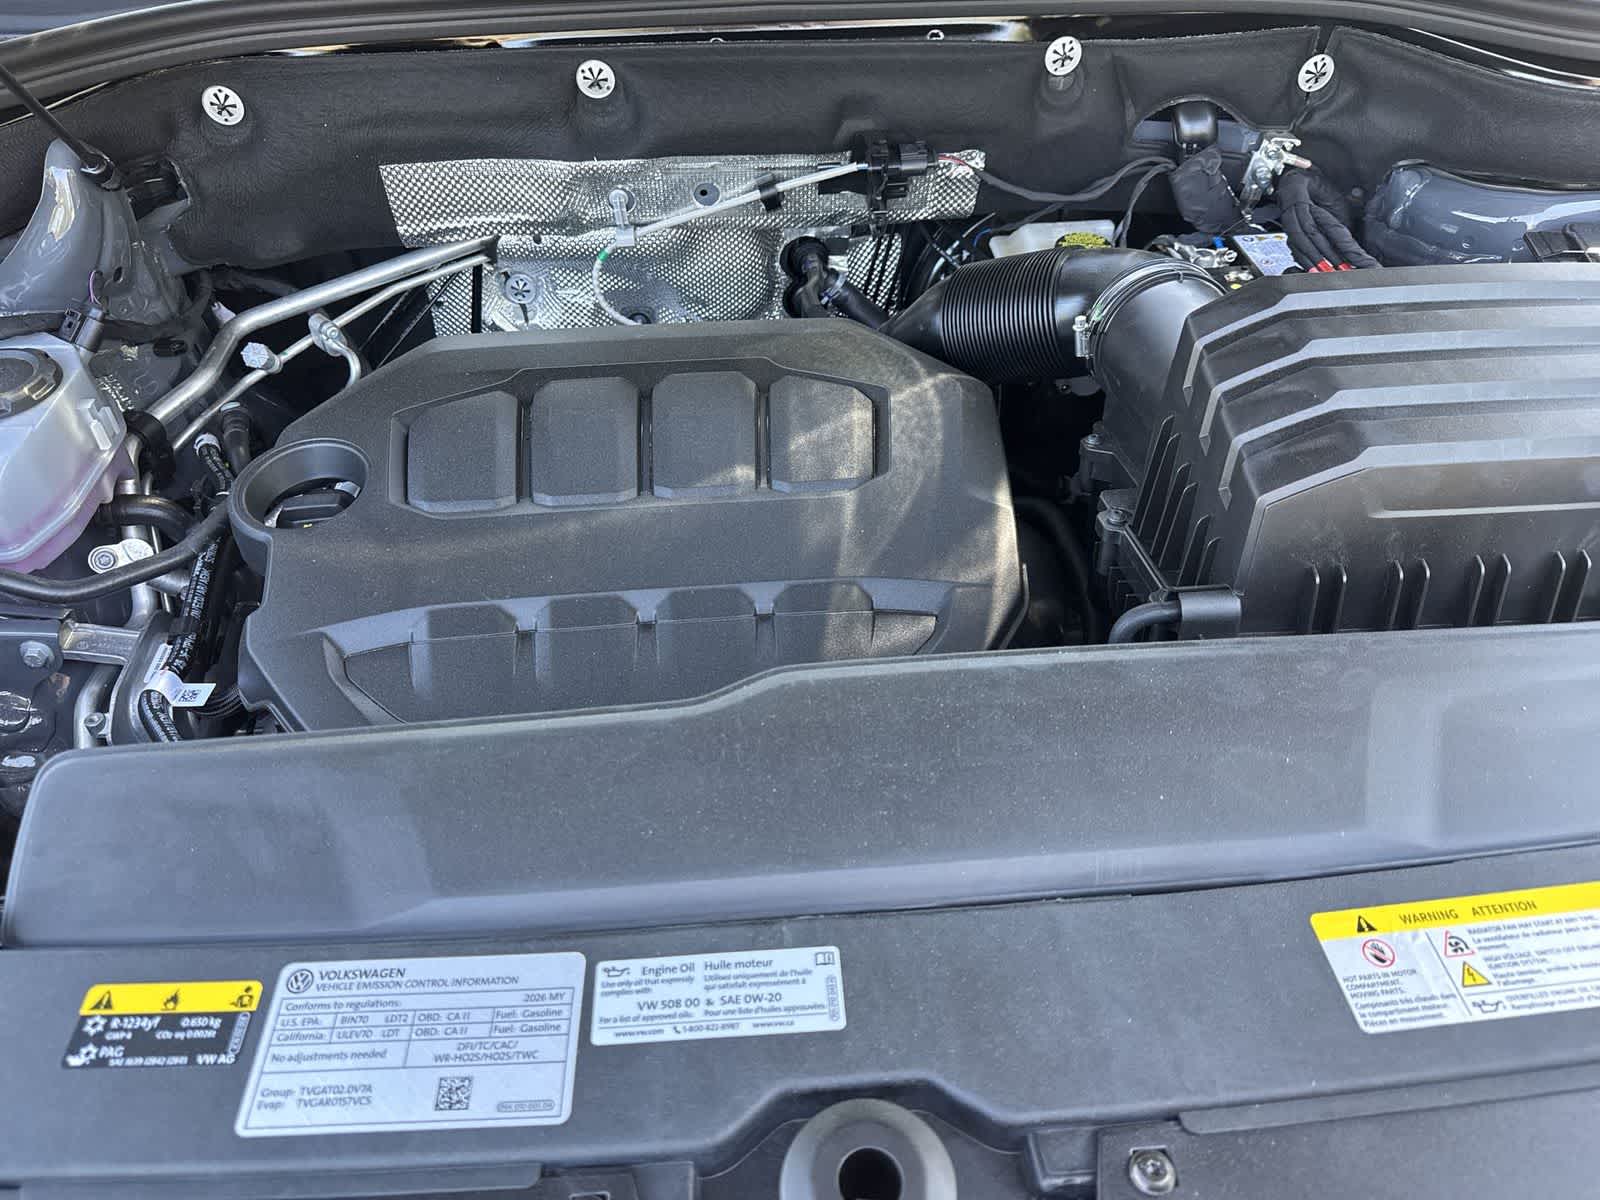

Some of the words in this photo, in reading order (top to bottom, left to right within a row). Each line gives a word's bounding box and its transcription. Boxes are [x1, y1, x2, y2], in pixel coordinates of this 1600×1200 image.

[1400, 909, 1458, 925] WARNING
[1471, 900, 1537, 917] ATTENTION
[705, 960, 732, 971] Huile
[735, 959, 773, 969] moteur
[317, 968, 406, 981] VOLKSWAGEN
[642, 965, 677, 978] Engine
[680, 963, 695, 973] Oil
[1342, 975, 1357, 983] HOT
[1358, 972, 1380, 980] PARTS
[315, 982, 354, 992] VEHICLE
[356, 981, 401, 990] EMISSION
[404, 979, 448, 988] CONTROL
[451, 976, 519, 987] INFORMATION
[524, 993, 546, 1002] 2026
[549, 993, 566, 1001] MY
[637, 1001, 658, 1011] VW
[660, 999, 681, 1009] 508
[685, 998, 700, 1008] 00
[706, 998, 714, 1006] &
[720, 995, 741, 1005] SAE
[744, 993, 782, 1004] 0W-20
[286, 1002, 331, 1011] Conforms
[334, 1001, 345, 1009] to
[384, 1014, 409, 1023] LDT2
[418, 1013, 441, 1022] OBD:
[496, 1010, 516, 1019] Fuel:
[522, 1008, 562, 1018] Gasoline
[415, 1028, 439, 1036] OBD:
[494, 1025, 514, 1033] Fuel:
[520, 1023, 561, 1032] Gasoline
[381, 1029, 400, 1038] LDT
[99, 1047, 125, 1057] PAG
[271, 1054, 285, 1063] No
[287, 1051, 348, 1064] adjustments
[351, 1048, 387, 1059] needed
[195, 1055, 216, 1064] VW
[218, 1055, 236, 1064] AG
